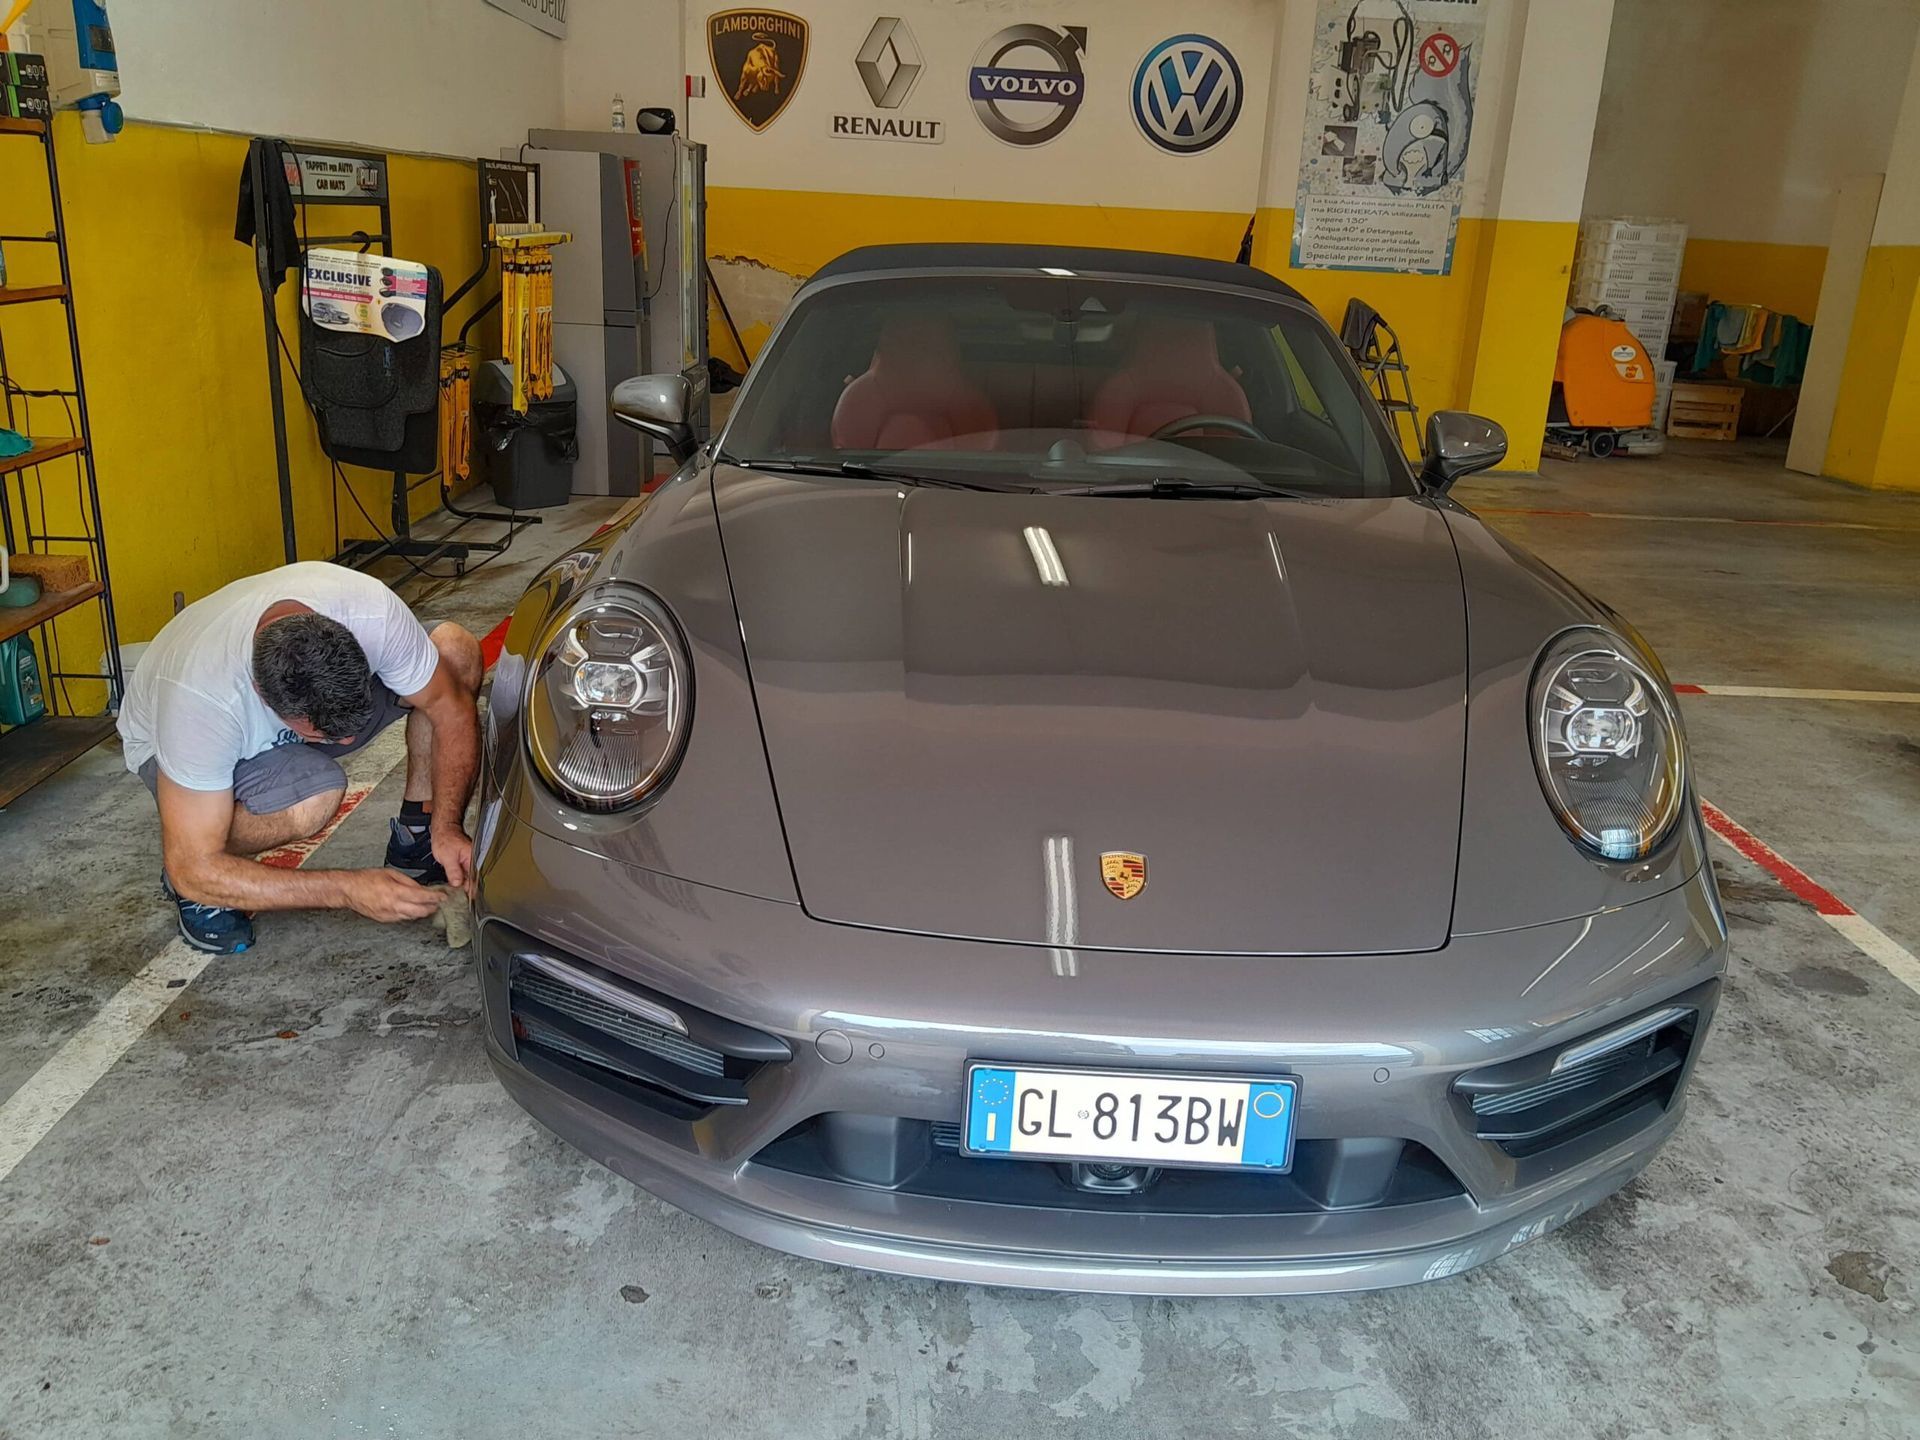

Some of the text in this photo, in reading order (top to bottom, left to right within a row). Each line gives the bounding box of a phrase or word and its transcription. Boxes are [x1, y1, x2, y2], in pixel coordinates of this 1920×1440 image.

[715, 16, 801, 40] LAMBORGHINI
[977, 74, 1077, 96] VOLVO
[833, 115, 940, 139] RENAULT
[305, 160, 328, 172] TAPPETI
[338, 162, 354, 173] AUTO
[316, 178, 346, 191] CAR MATS
[1326, 207, 1390, 216] RIGENERATA
[1314, 225, 1341, 233] Acqua
[1366, 226, 1414, 236] Detergente
[1313, 234, 1364, 243] Asciugatura
[1312, 243, 1371, 251] Ozonizzazione
[1306, 252, 1346, 261] Speciale
[1408, 257, 1431, 265] pelle
[307, 267, 372, 287] EXCLUSIVE
[1018, 1088, 1245, 1147] GL 813BW
